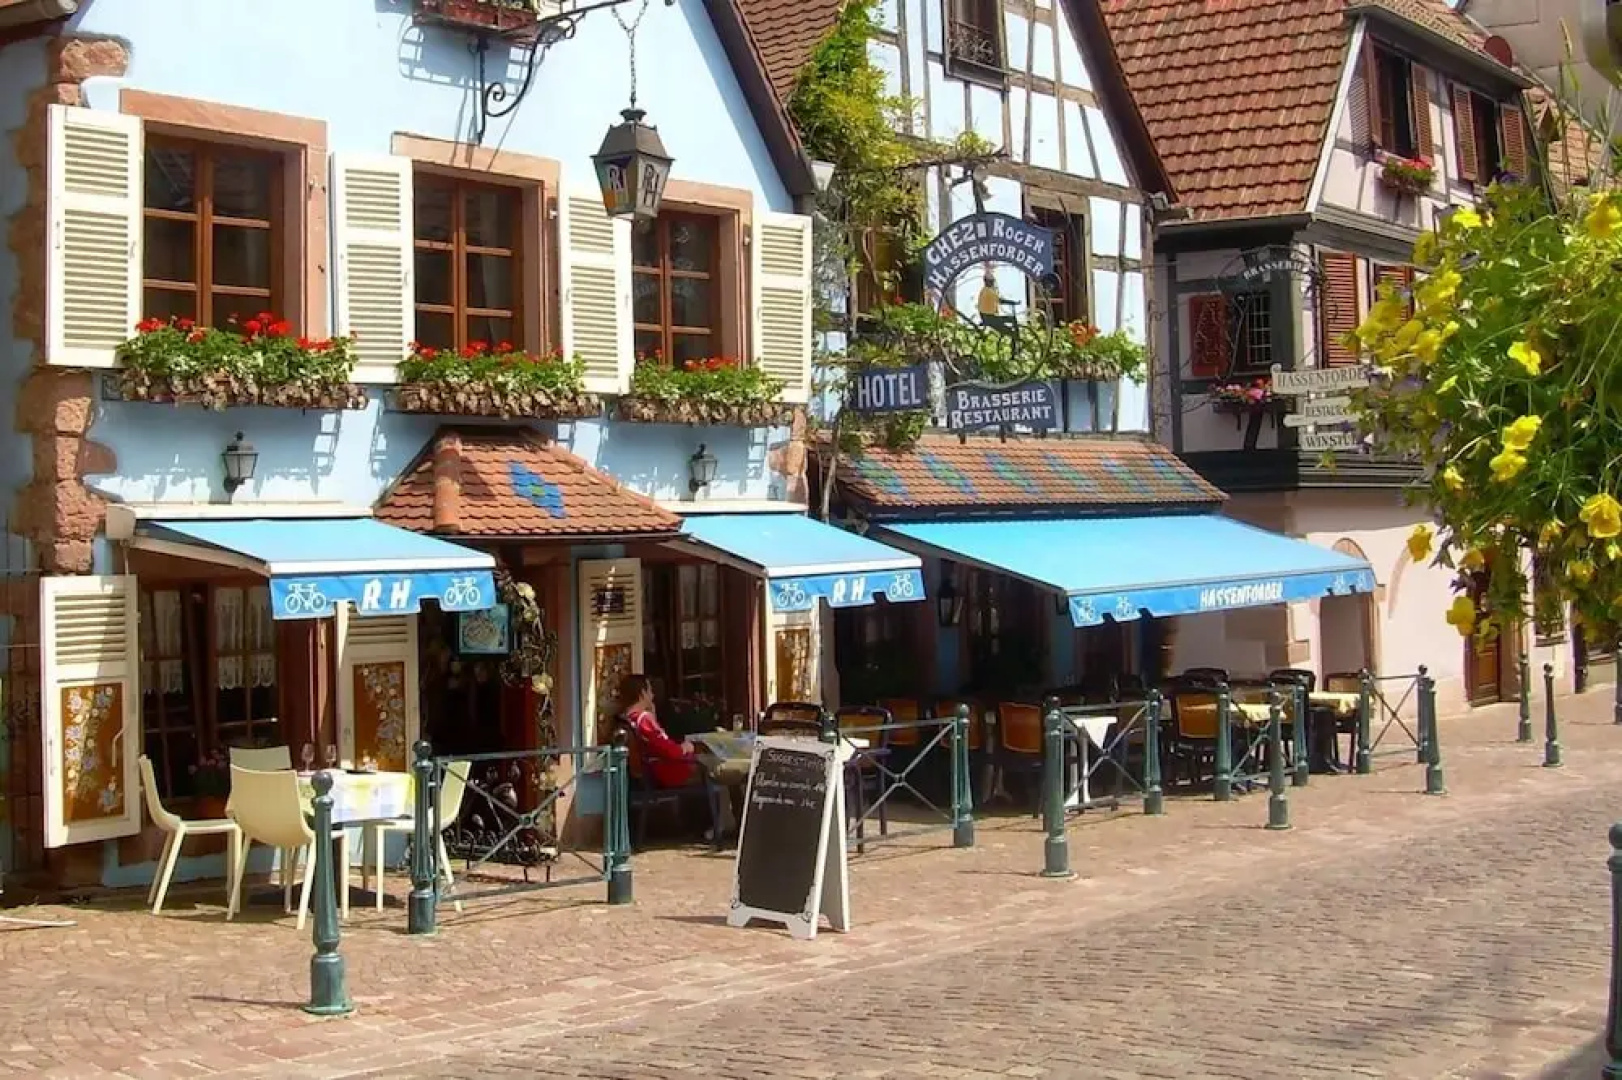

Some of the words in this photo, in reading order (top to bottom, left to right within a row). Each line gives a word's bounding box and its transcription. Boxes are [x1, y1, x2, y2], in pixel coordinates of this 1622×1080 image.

[926, 221, 976, 266] CHEZ
[992, 218, 1045, 254] ROGER
[928, 243, 1045, 289] HASSENFORDER
[857, 372, 921, 408] HOTEL
[956, 388, 1047, 409] BRASSERIE
[951, 405, 1052, 429] RESTAURANT
